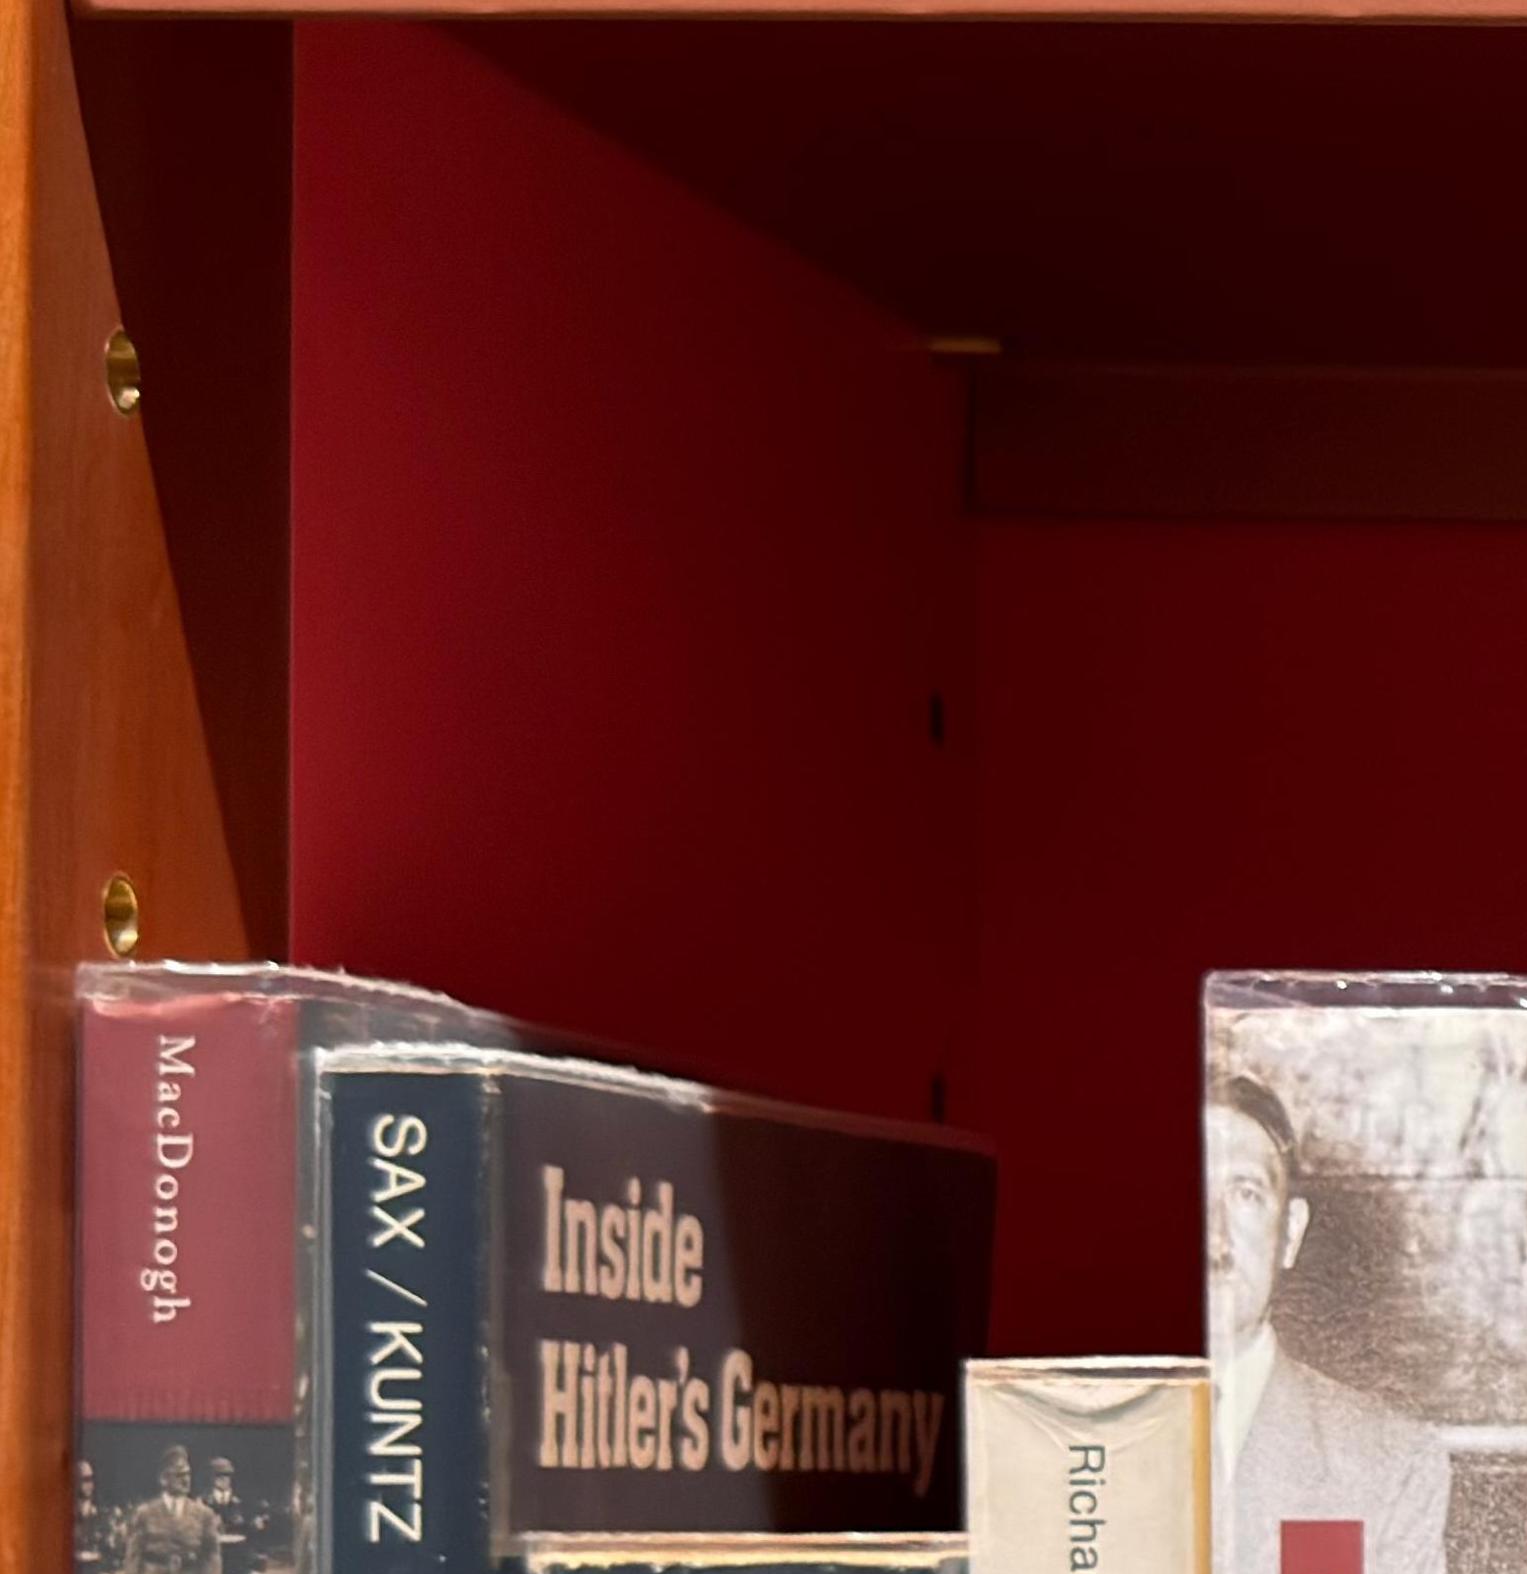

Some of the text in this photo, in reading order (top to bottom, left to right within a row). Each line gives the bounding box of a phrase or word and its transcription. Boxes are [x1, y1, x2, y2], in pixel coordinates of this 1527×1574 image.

[140, 1034, 197, 1326] MacDonogh
[541, 1165, 704, 1309] Inside
[364, 1114, 427, 1544] SAX KUNTZ
[539, 1340, 943, 1496] Hitler's Germany
